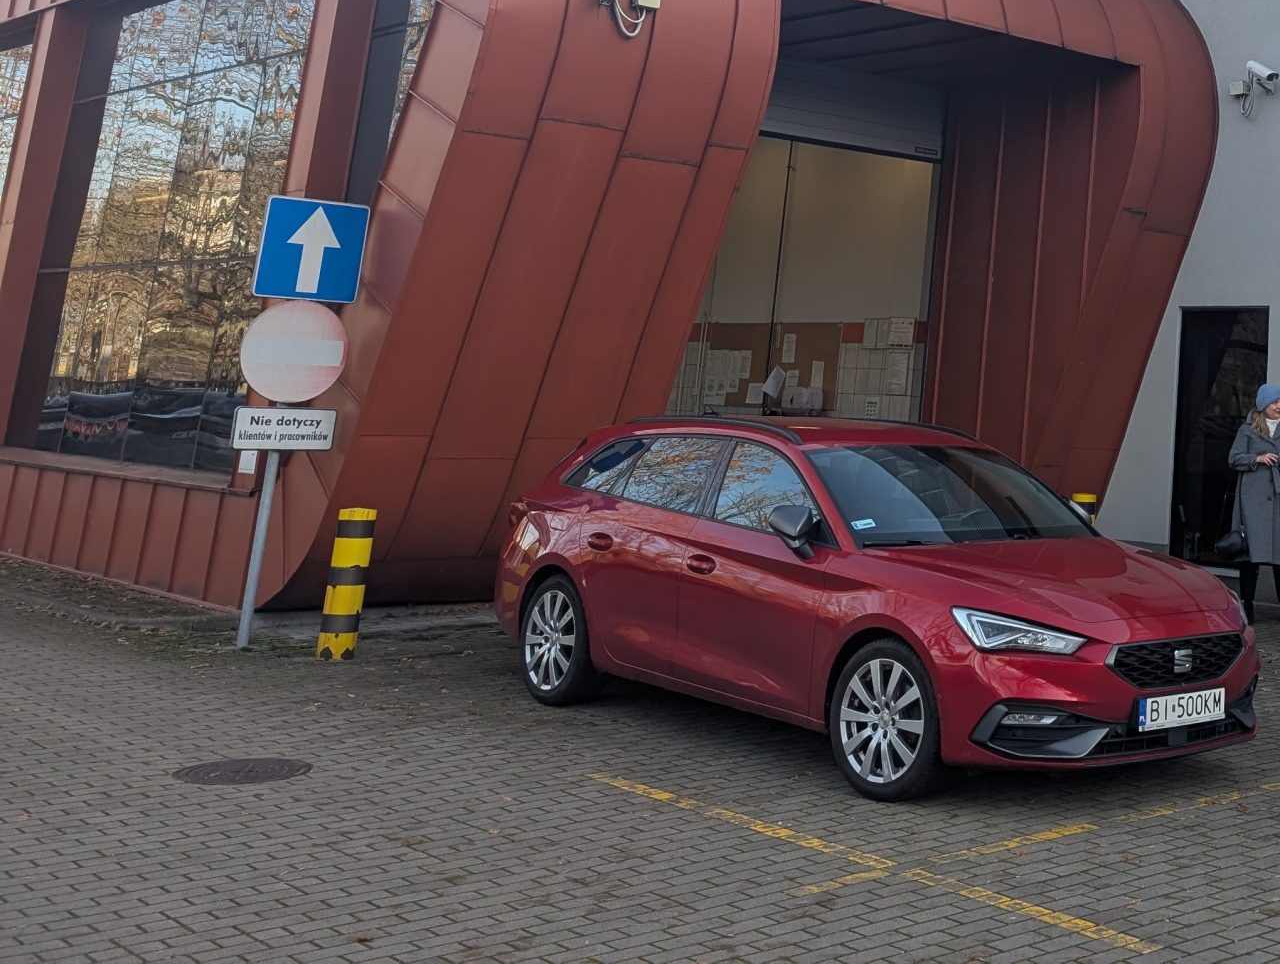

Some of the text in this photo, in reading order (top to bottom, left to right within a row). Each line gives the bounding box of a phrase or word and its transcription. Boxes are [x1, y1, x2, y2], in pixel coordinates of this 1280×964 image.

[249, 416, 322, 429] Nie dotyczy
[238, 430, 272, 441] klientów
[279, 430, 329, 443] pracowników
[1150, 691, 1222, 722] BI 500KM
